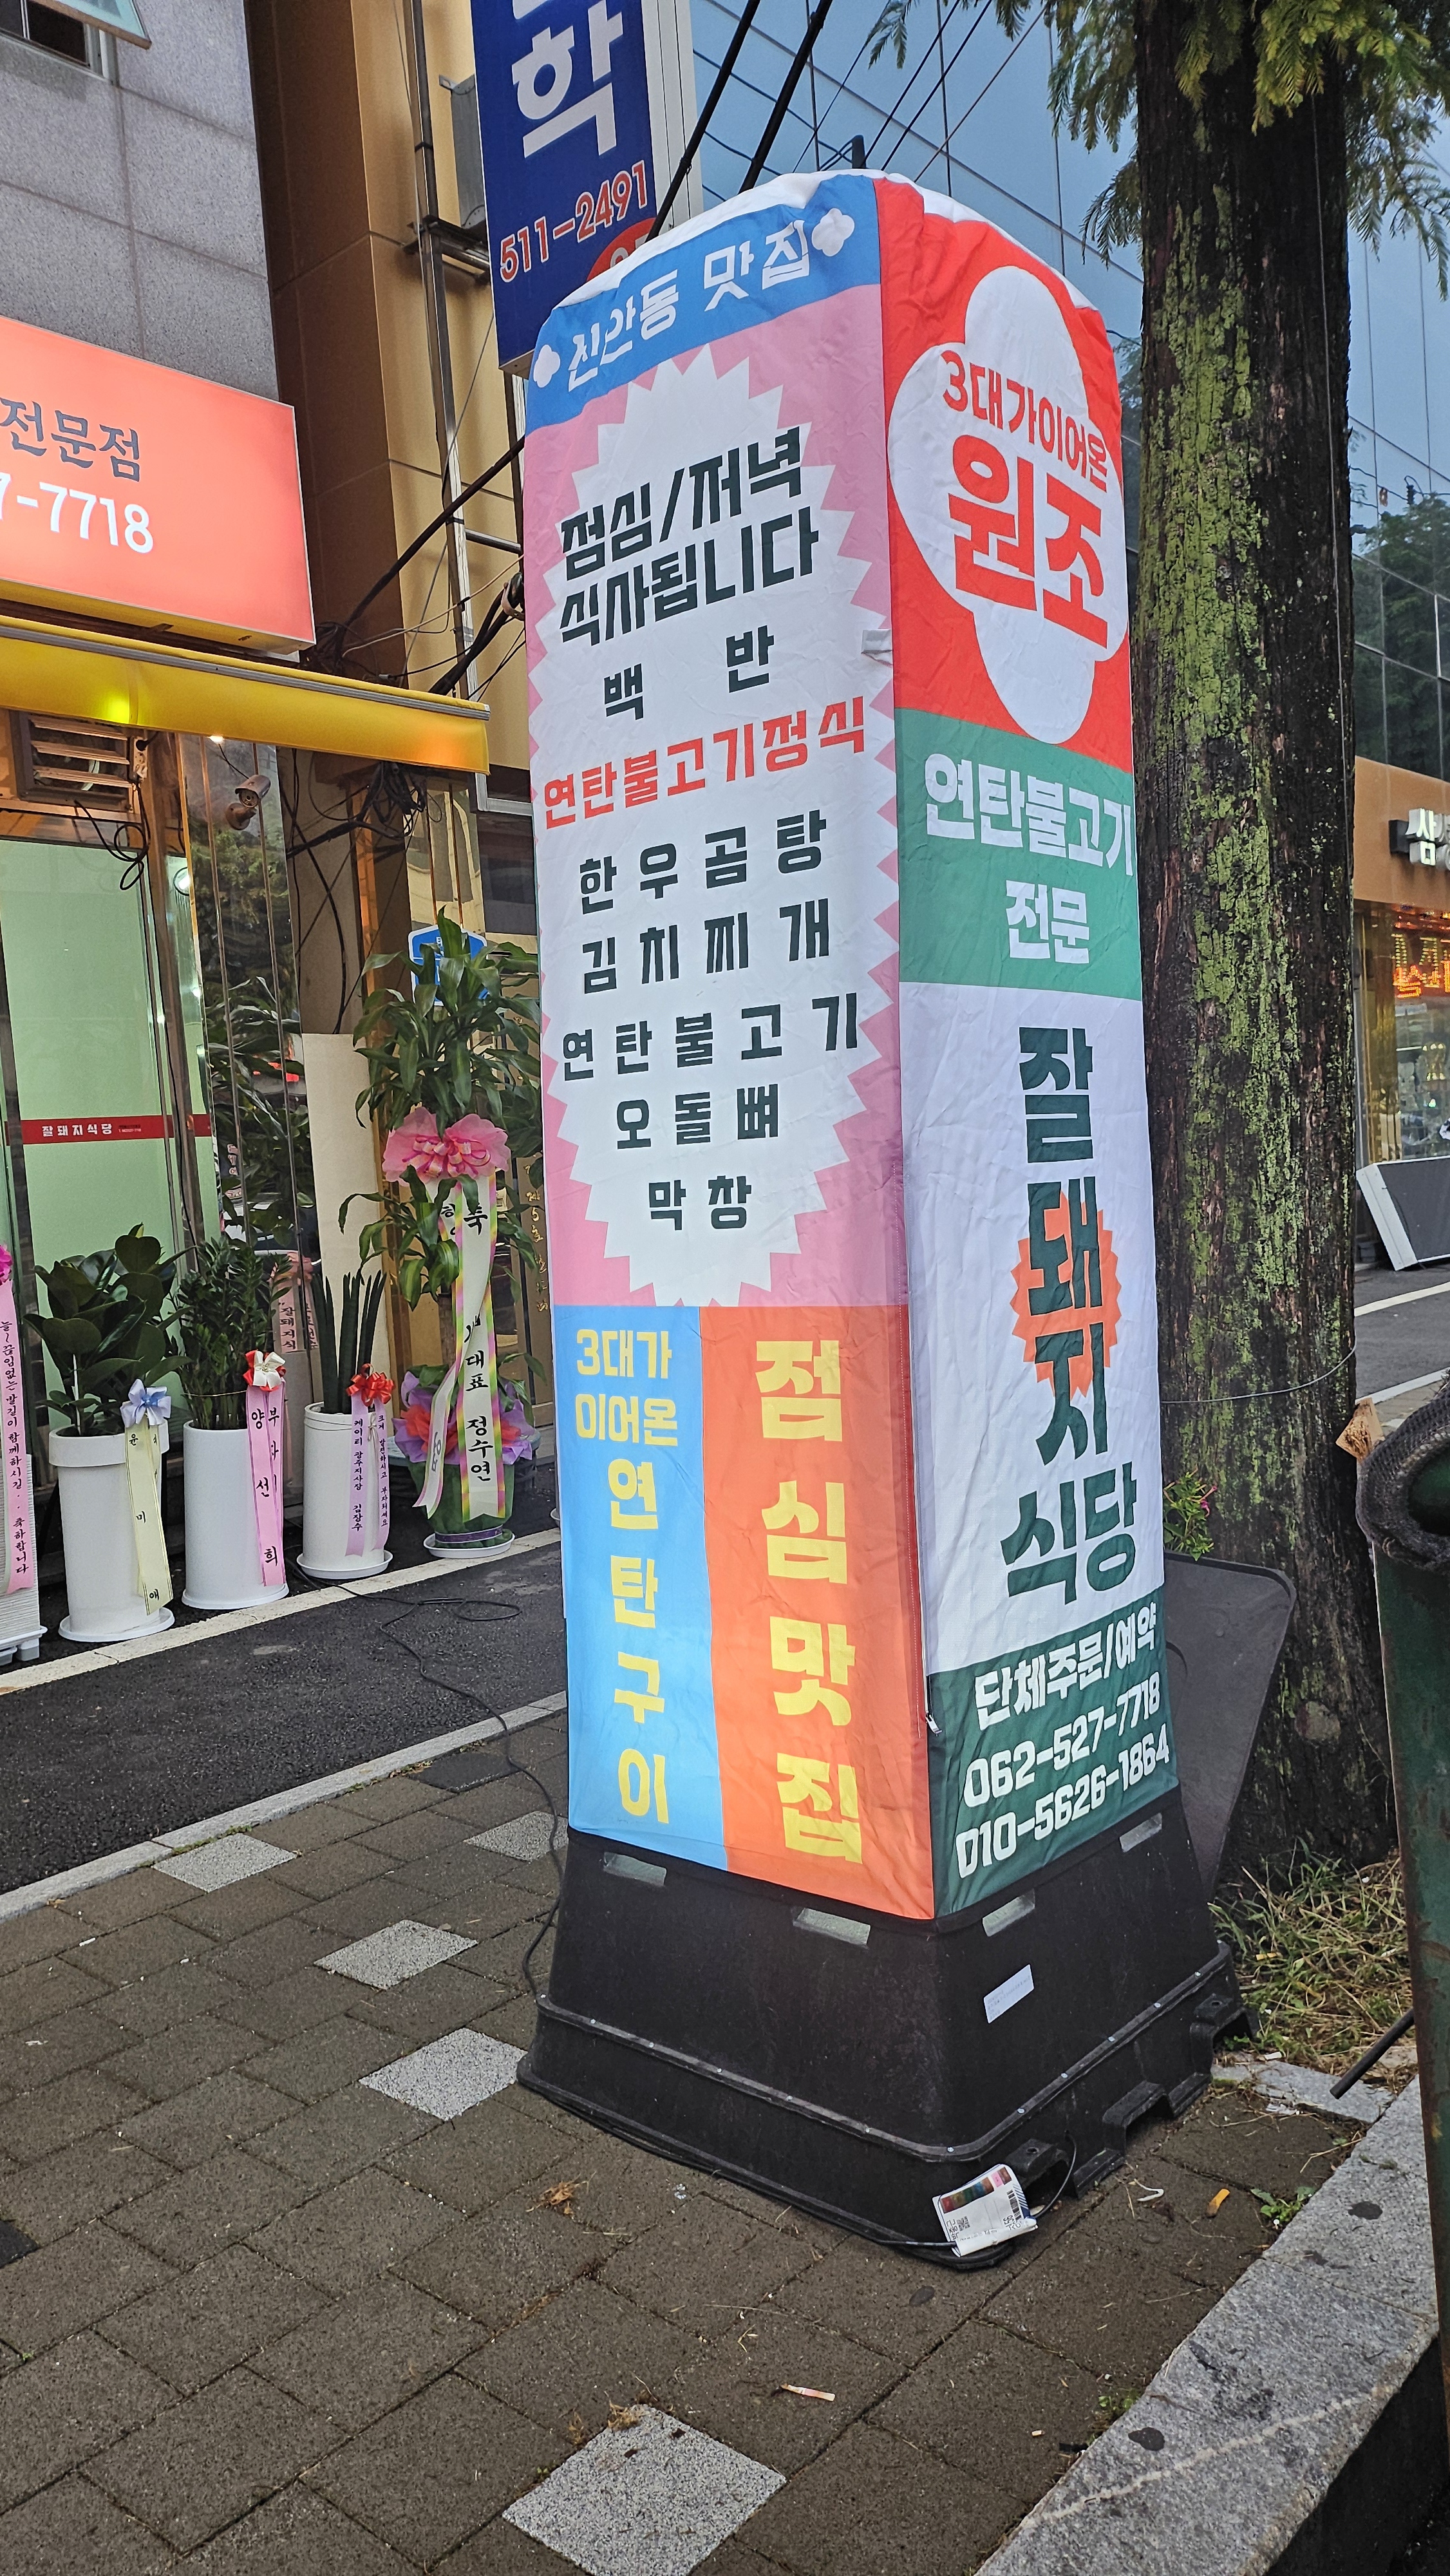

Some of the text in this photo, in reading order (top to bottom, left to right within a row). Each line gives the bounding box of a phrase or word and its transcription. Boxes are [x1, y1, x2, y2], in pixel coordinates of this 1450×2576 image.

[512, 0, 623, 158] 학
[500, 160, 648, 283] 511-2491
[568, 220, 810, 392] 신안동 맛집
[0, 397, 140, 482] 전문점
[560, 506, 819, 646] 식사됩니다
[948, 434, 1108, 649] 원조
[925, 753, 1133, 876] 연탄불고기
[1006, 880, 1089, 964] 전문
[42, 1123, 112, 1137] 잘돼지식당
[465, 1350, 489, 1392] 대표
[576, 1328, 672, 1379] 3대가
[353, 1419, 363, 1446] 케이티
[466, 1416, 494, 1482] 정수연
[575, 1393, 679, 1446] 이어온
[13, 1517, 29, 1574] 축하합니다
[1000, 1461, 1138, 1605] 식당
[974, 1601, 1157, 1731] 단체주문/예약
[955, 1722, 1171, 1879] 010-5626-1864
[963, 1671, 1161, 1808] 062-527-7718
